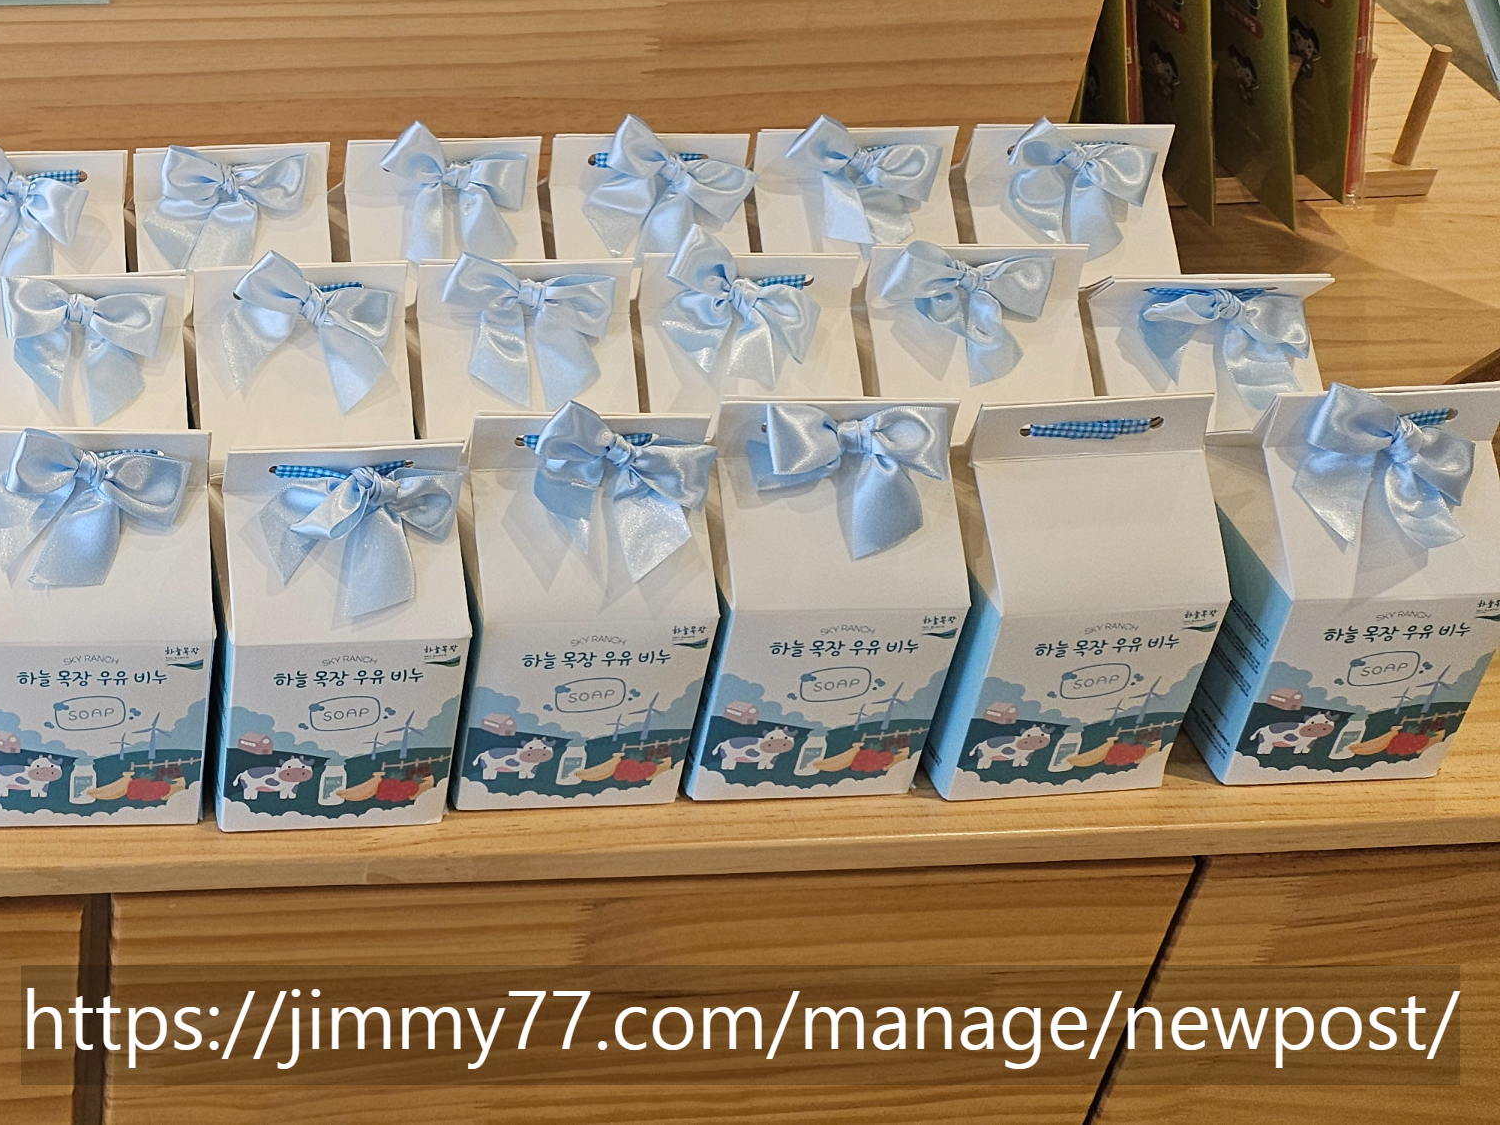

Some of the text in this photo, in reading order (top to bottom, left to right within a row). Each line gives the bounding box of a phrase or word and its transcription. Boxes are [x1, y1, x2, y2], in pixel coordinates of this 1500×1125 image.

[1324, 623, 1470, 643] 하늘 목장 우유 비누
[770, 639, 918, 657] 하늘 목장 우유 비누
[1035, 635, 1179, 658] 하늘 목장 우유 비누
[522, 650, 671, 669] 하늘 목장 우유 비누
[274, 668, 423, 688] 하늘 목장 우유 비누
[1359, 660, 1410, 678] SOAP
[17, 670, 167, 687] 하늘 목장 우유 비누
[811, 677, 862, 694] SOAP
[1071, 673, 1121, 692] SOAP
[566, 688, 617, 705] SOAP
[66, 705, 114, 721] SOAP
[321, 706, 369, 721] SOAP
